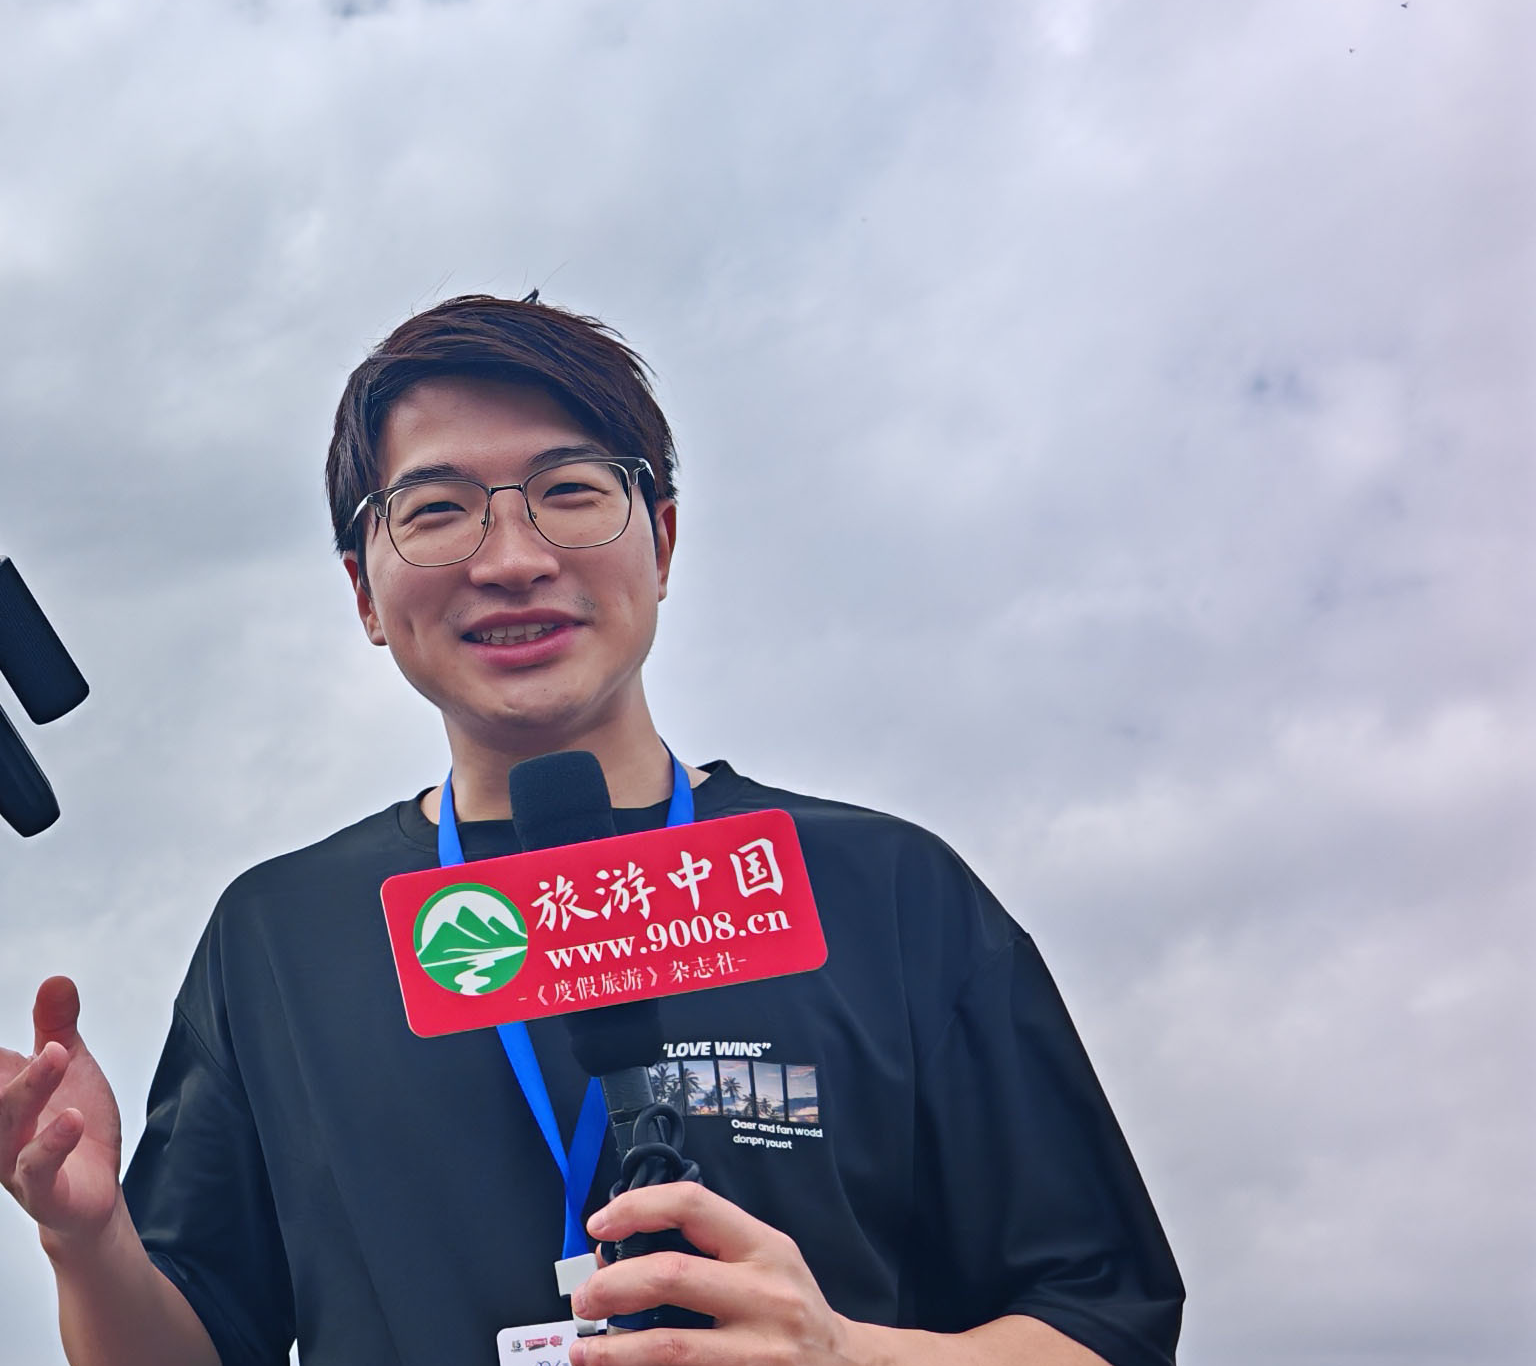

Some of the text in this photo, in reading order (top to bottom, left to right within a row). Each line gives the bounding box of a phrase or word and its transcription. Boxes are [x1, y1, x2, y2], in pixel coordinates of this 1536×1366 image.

[531, 838, 784, 932] 旅游中国
[545, 909, 792, 970] www.9008.cn
